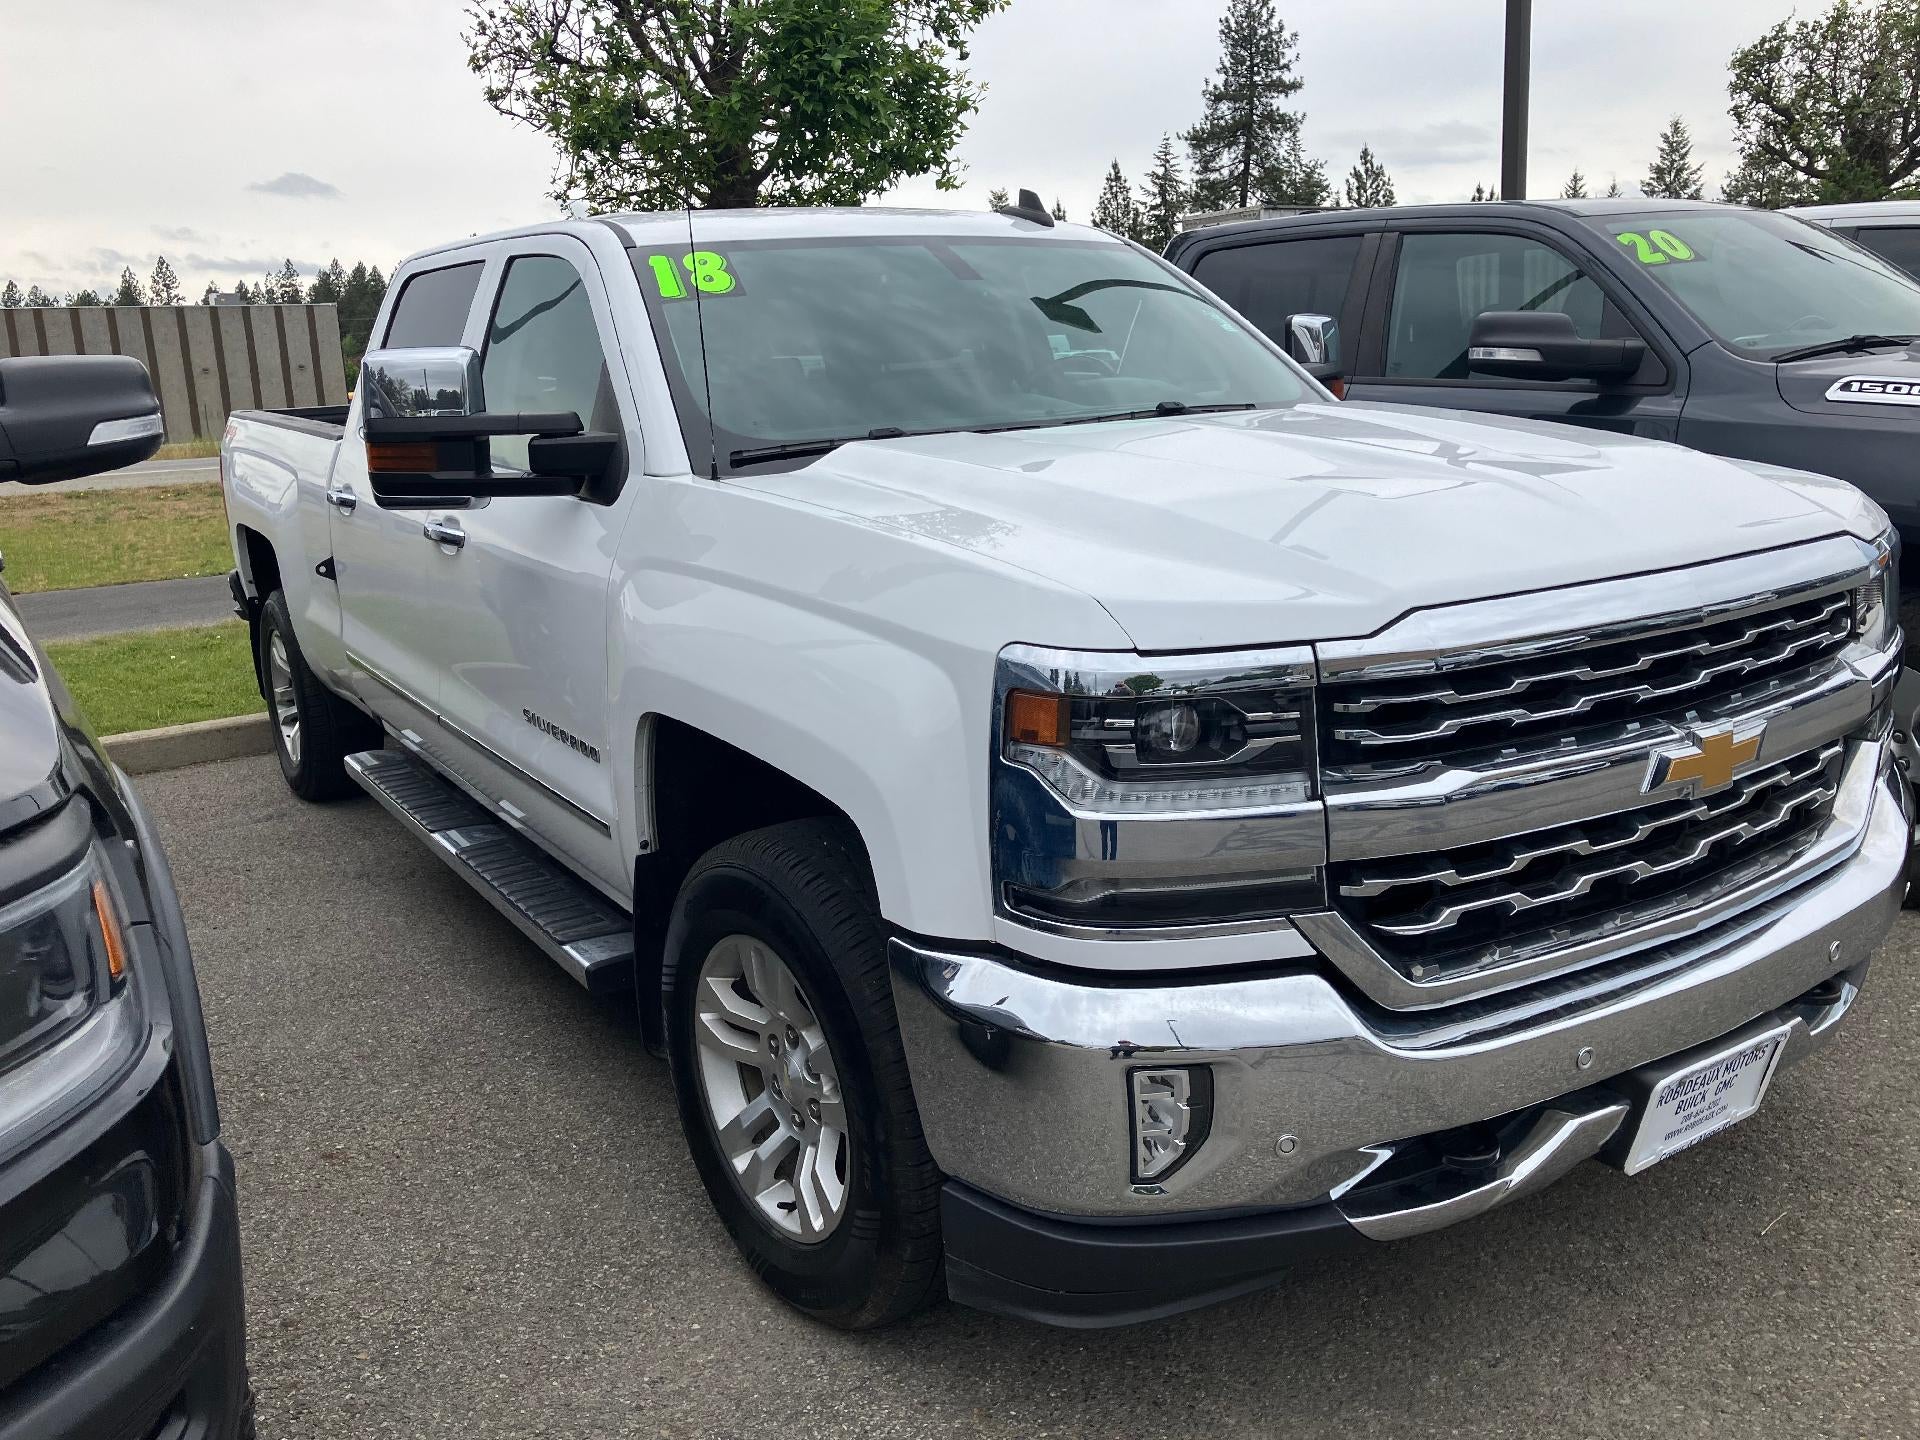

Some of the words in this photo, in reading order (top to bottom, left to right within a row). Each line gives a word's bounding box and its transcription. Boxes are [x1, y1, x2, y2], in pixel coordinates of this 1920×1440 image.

[1616, 229, 1695, 265] 20
[648, 250, 736, 299] 18
[522, 708, 601, 764] SILVERADO
[1656, 1062, 1723, 1108] ROBIDEAUX
[1722, 1044, 1768, 1077] MOTORS
[1675, 1088, 1709, 1115] BUICK
[1715, 1074, 1738, 1096] GMC
